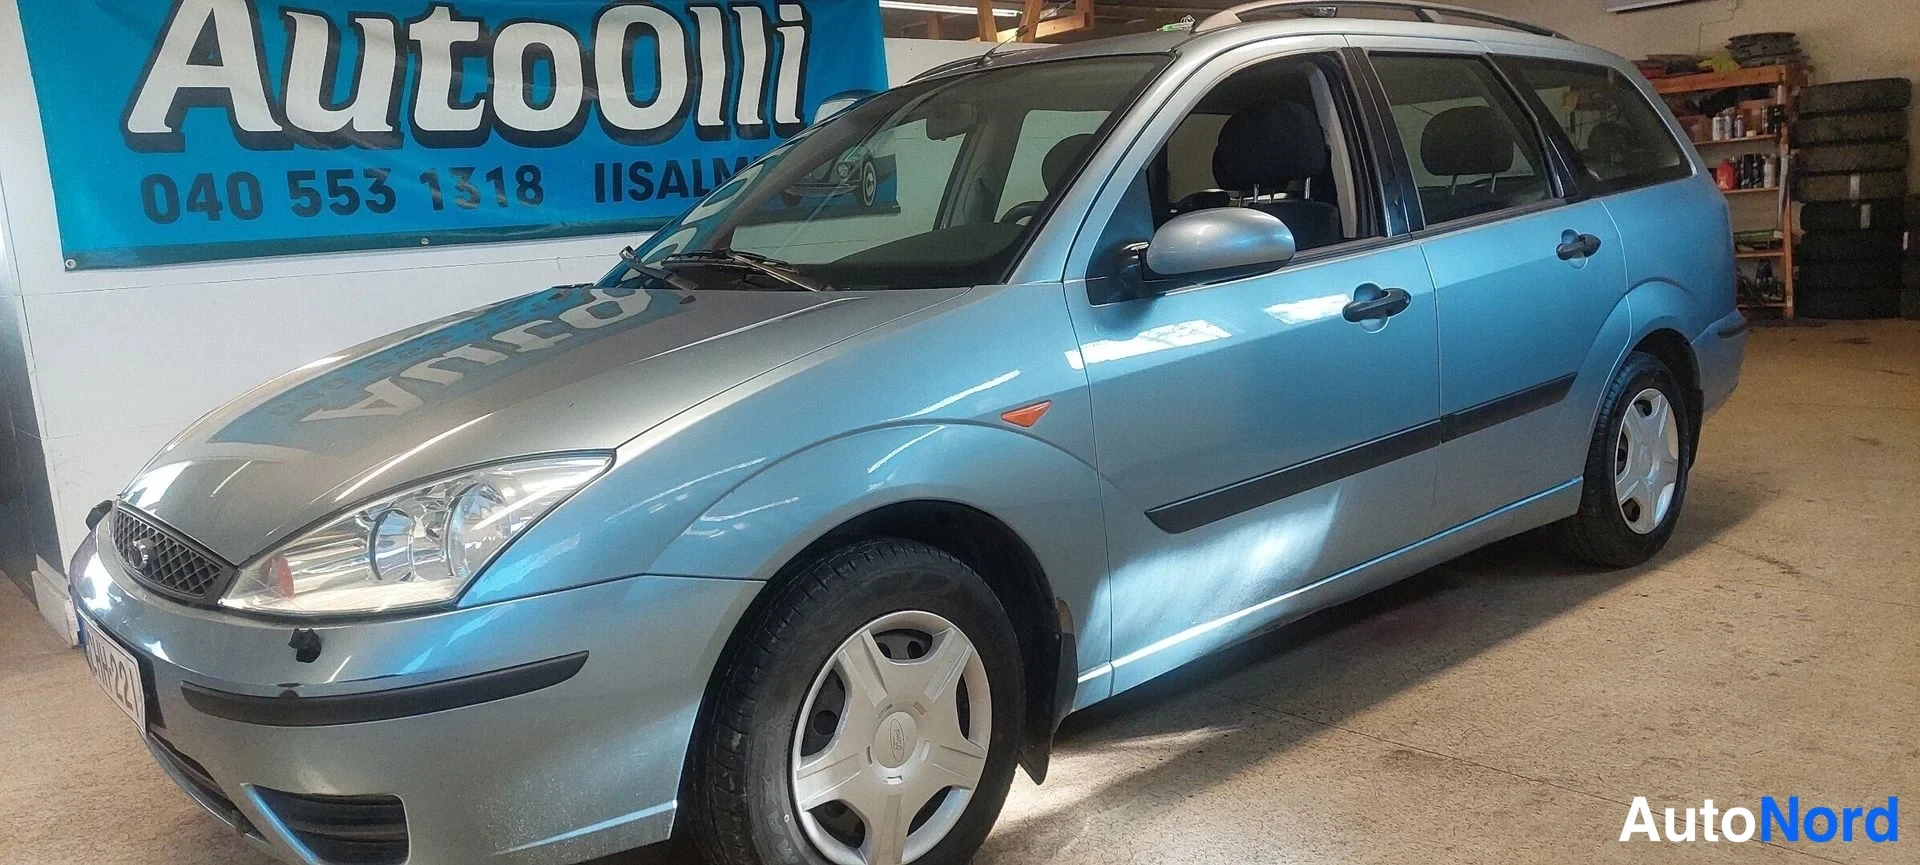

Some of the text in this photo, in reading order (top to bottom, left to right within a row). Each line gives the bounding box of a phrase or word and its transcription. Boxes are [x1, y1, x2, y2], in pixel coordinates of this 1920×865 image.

[121, 0, 808, 152] AutoOlli
[140, 156, 765, 225] 040 553 1318 IISALM
